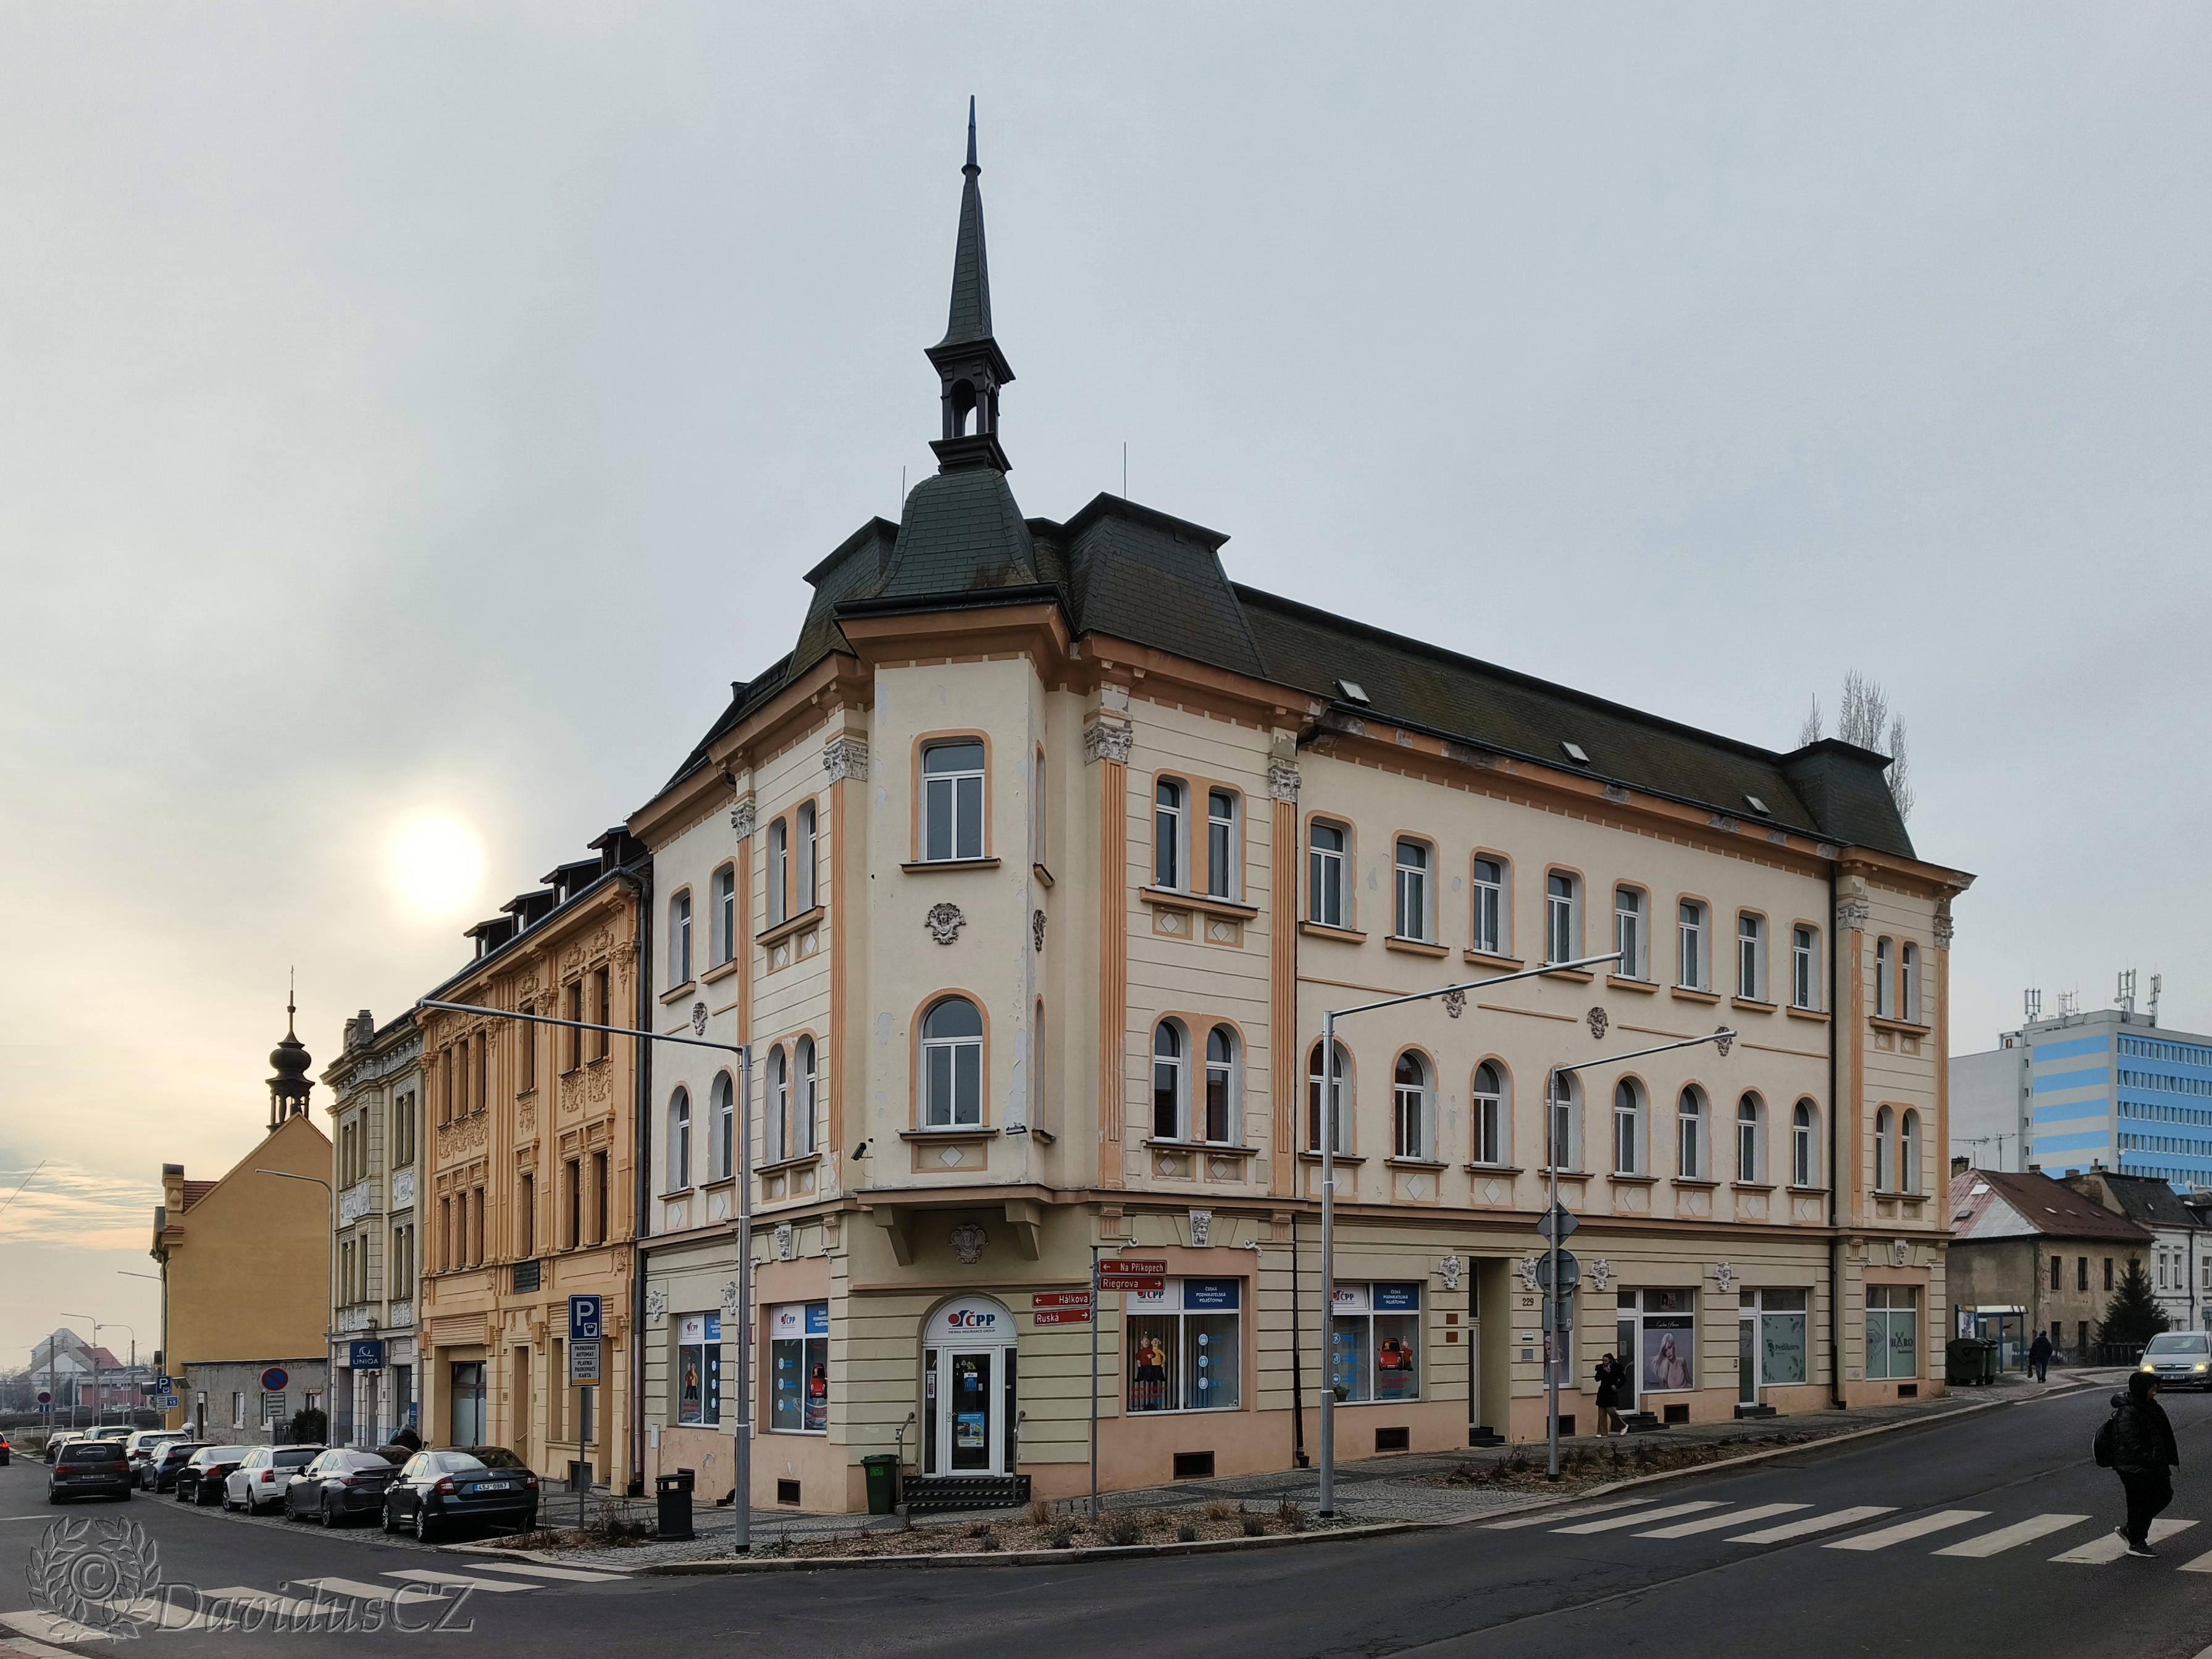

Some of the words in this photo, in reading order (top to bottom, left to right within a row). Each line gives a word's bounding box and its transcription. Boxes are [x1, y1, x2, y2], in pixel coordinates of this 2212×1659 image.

[1121, 1263, 1128, 1271] Na
[1131, 1263, 1163, 1273] Příkopech
[1103, 1279, 1139, 1289] Riegrova
[1059, 1294, 1088, 1304] Hálkova
[1341, 1291, 1354, 1300] ČPP
[1522, 1298, 1534, 1306] 229
[577, 1301, 594, 1326] P
[966, 1311, 995, 1326] ČPP
[1037, 1313, 1059, 1323] Ruská
[786, 1314, 795, 1324] ČPP
[159, 1379, 168, 1389] P
